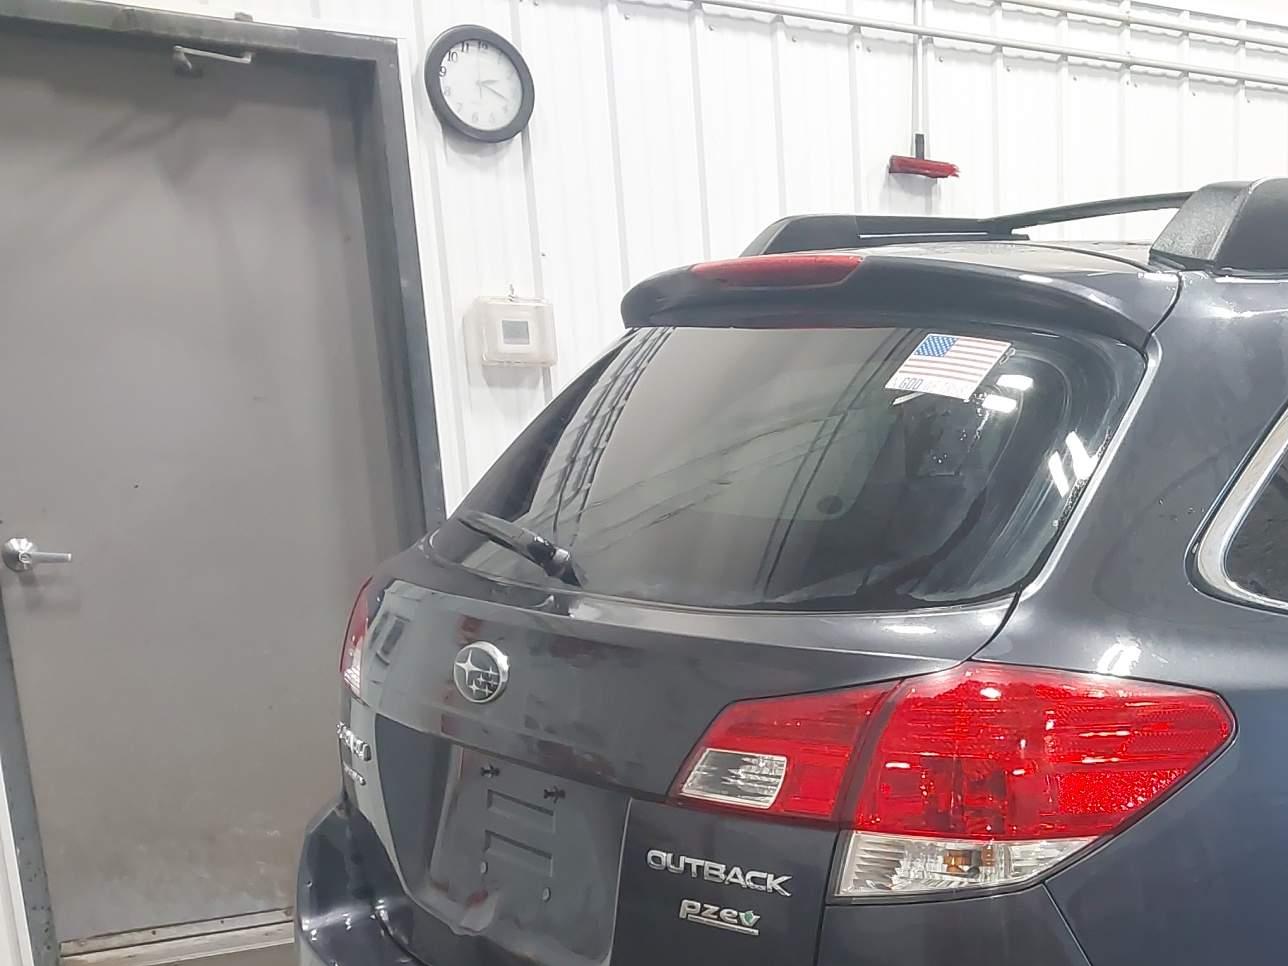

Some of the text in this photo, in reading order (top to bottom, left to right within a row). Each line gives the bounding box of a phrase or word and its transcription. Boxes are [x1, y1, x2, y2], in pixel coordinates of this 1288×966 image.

[447, 50, 458, 62] 10
[439, 66, 447, 77] 9
[647, 850, 792, 896] OUTBACK
